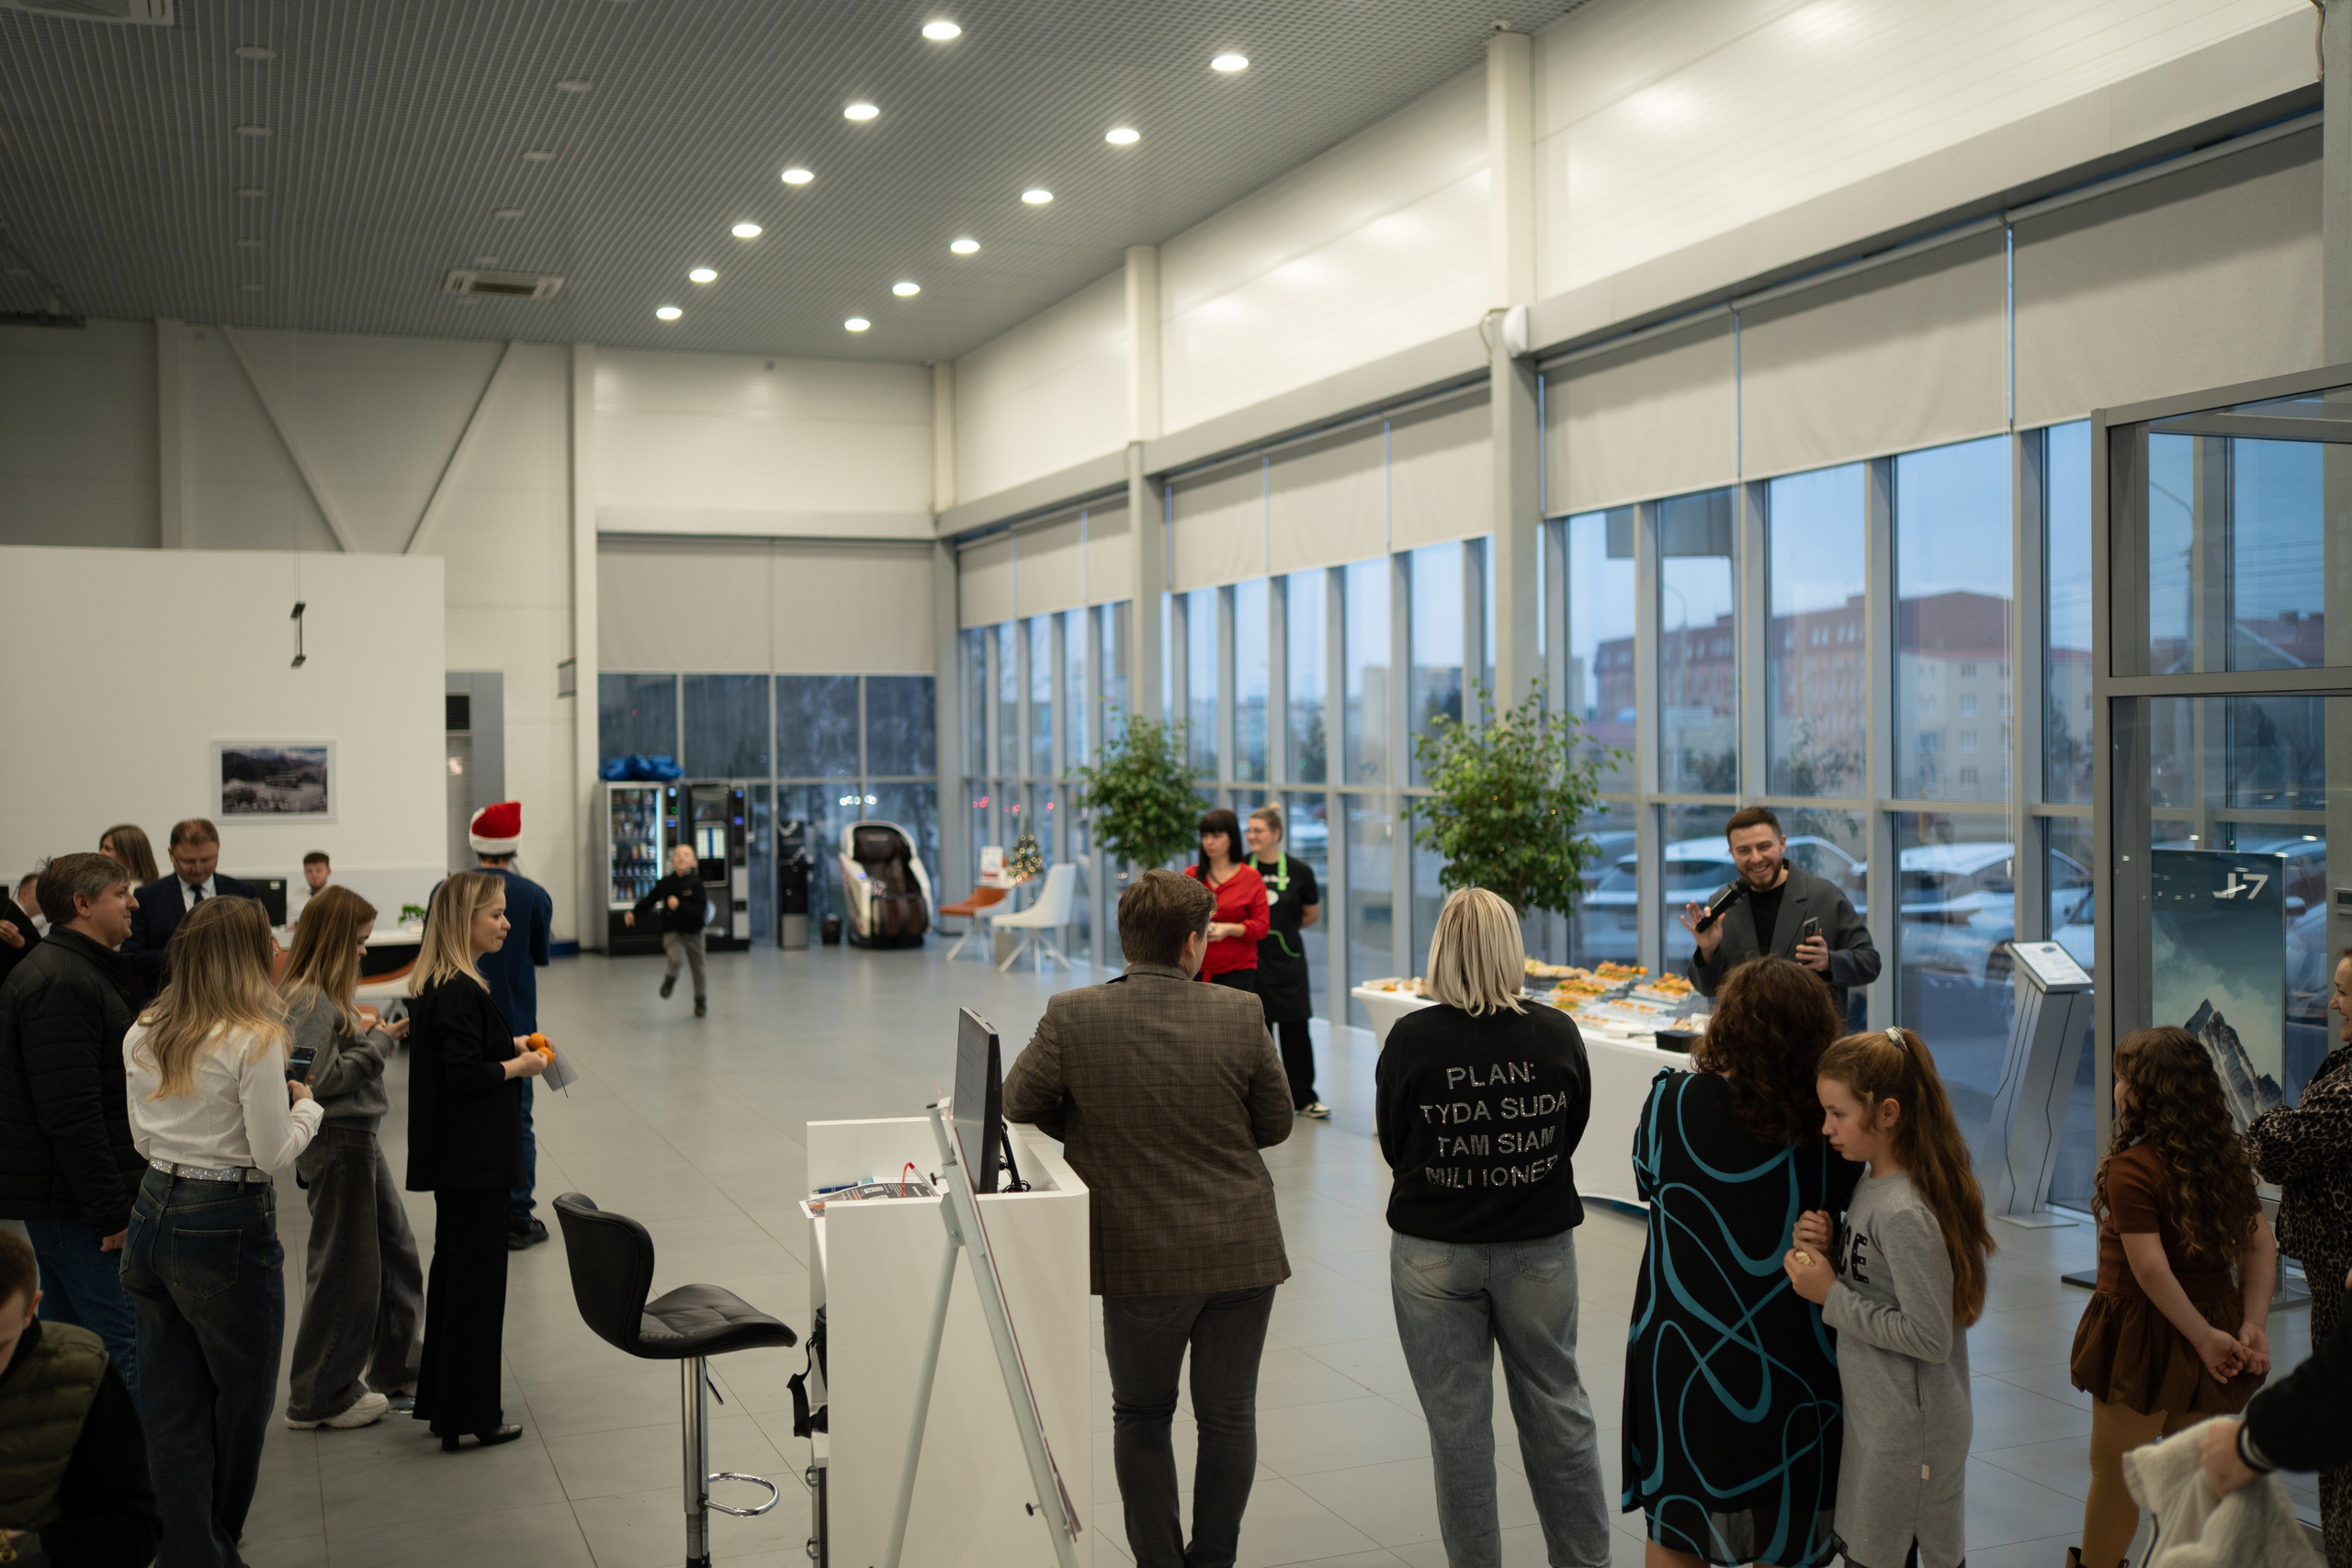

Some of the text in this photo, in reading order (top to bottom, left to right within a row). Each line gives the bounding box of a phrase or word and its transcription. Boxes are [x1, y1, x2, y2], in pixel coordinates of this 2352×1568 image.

[2212, 872, 2268, 899] J7
[1446, 1061, 1536, 1090] PLAN:
[1419, 1090, 1567, 1124] TYDA SUDA
[1438, 1125, 1555, 1157] TAM SIAM
